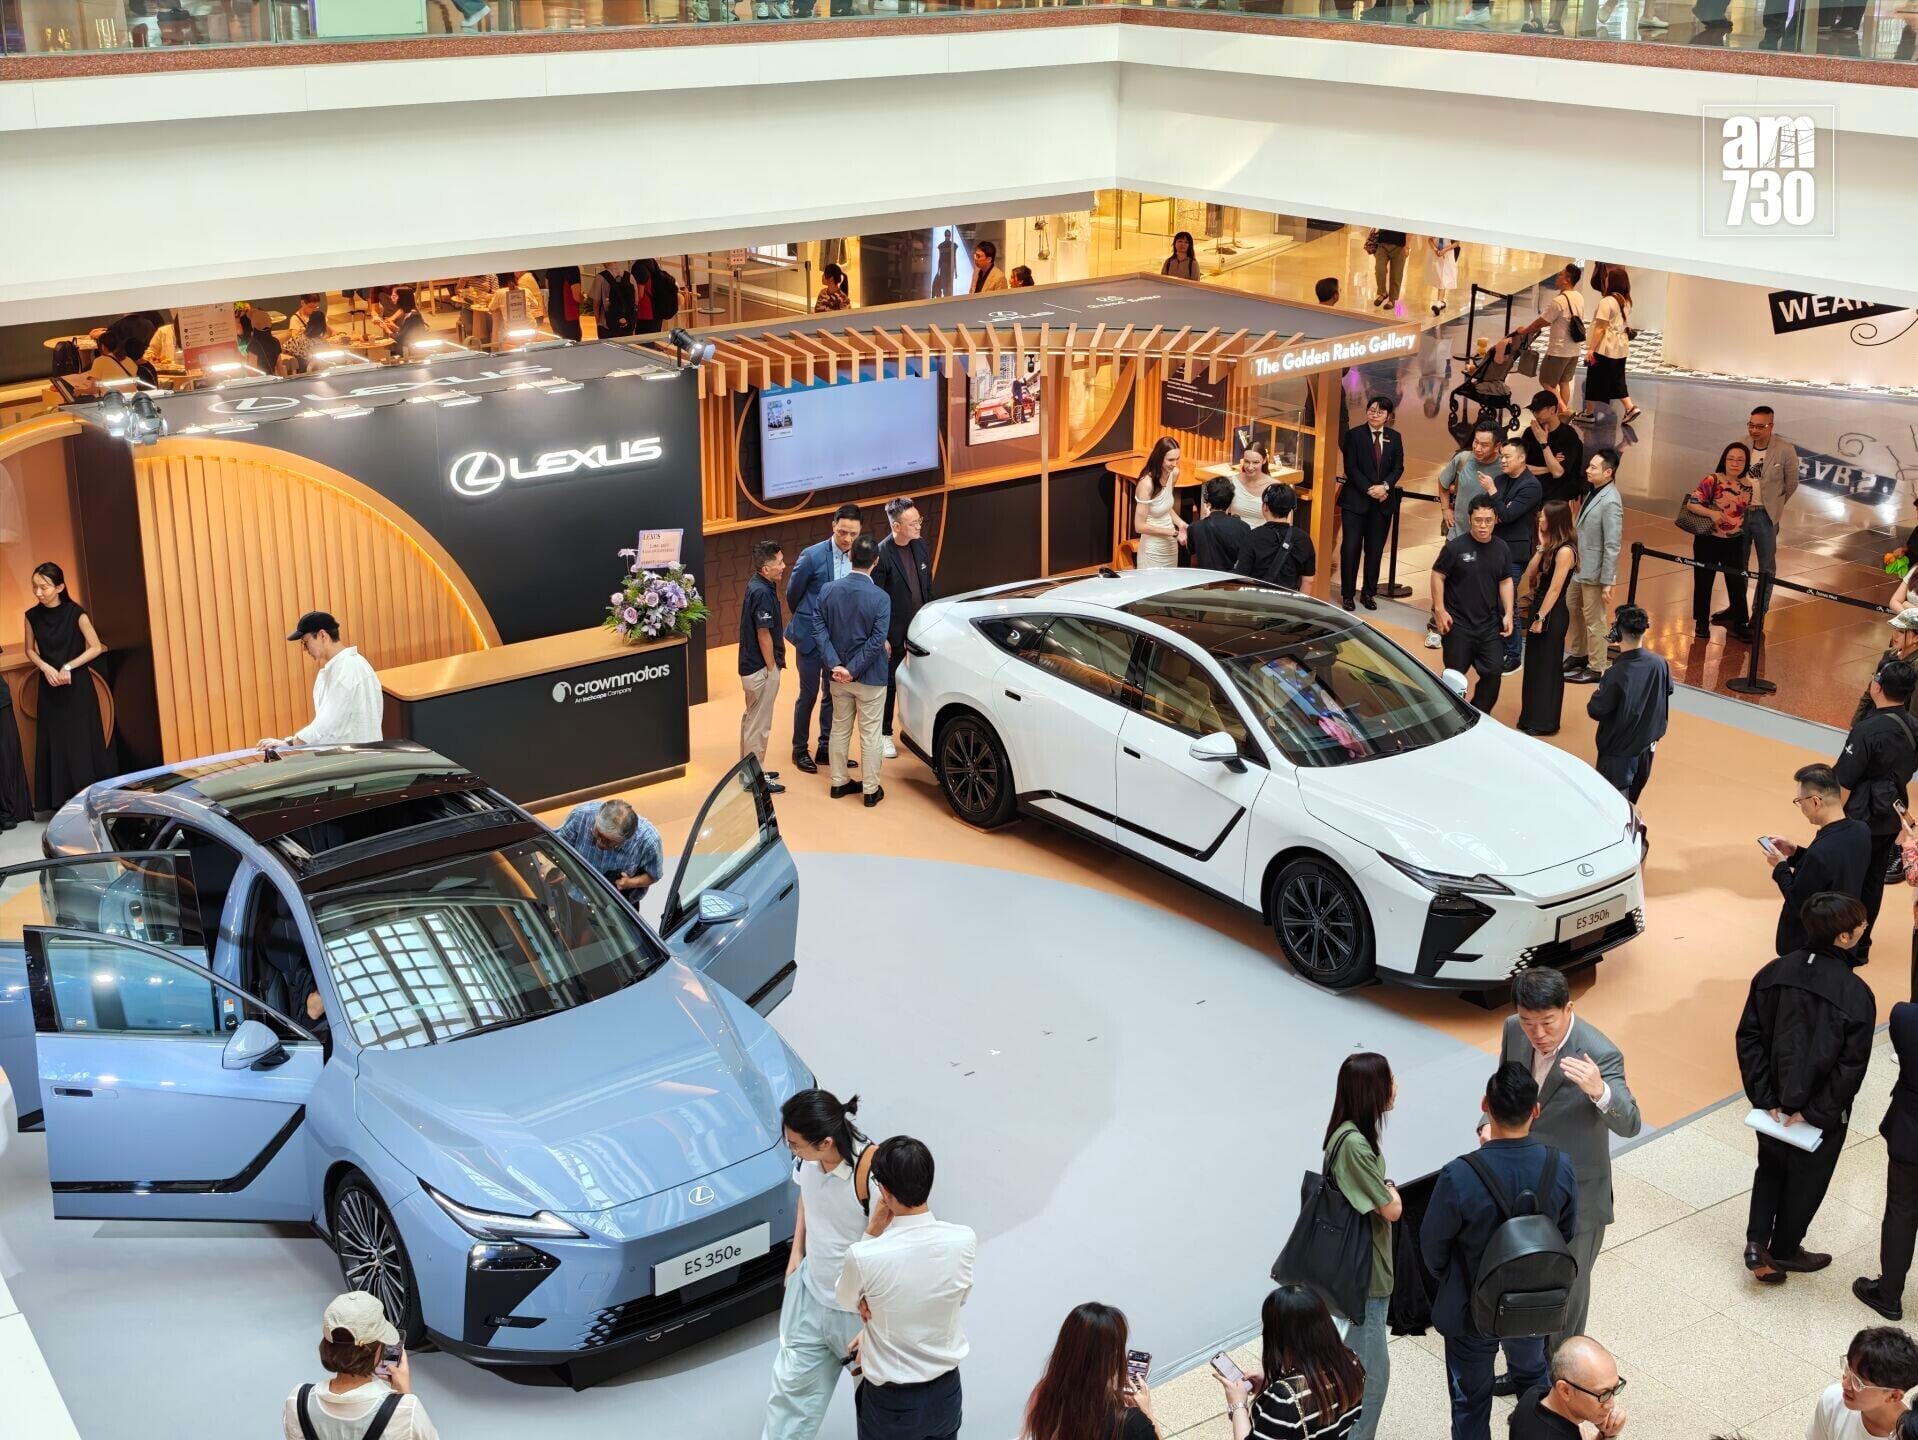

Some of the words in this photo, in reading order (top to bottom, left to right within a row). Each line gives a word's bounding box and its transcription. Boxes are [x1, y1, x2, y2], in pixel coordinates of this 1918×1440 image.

[1255, 357, 1280, 377] The
[1282, 349, 1330, 371] Golden
[1333, 341, 1366, 361] Ratio
[1368, 332, 1415, 354] Gallery
[303, 365, 552, 400] LEXUS
[509, 437, 662, 480] LEXUS
[574, 664, 670, 696] crownmotors
[607, 687, 632, 697] Company
[1576, 917, 1587, 930] ES
[1588, 908, 1610, 926] 350h
[684, 1258, 702, 1276] ES
[705, 1245, 742, 1268] 350e
